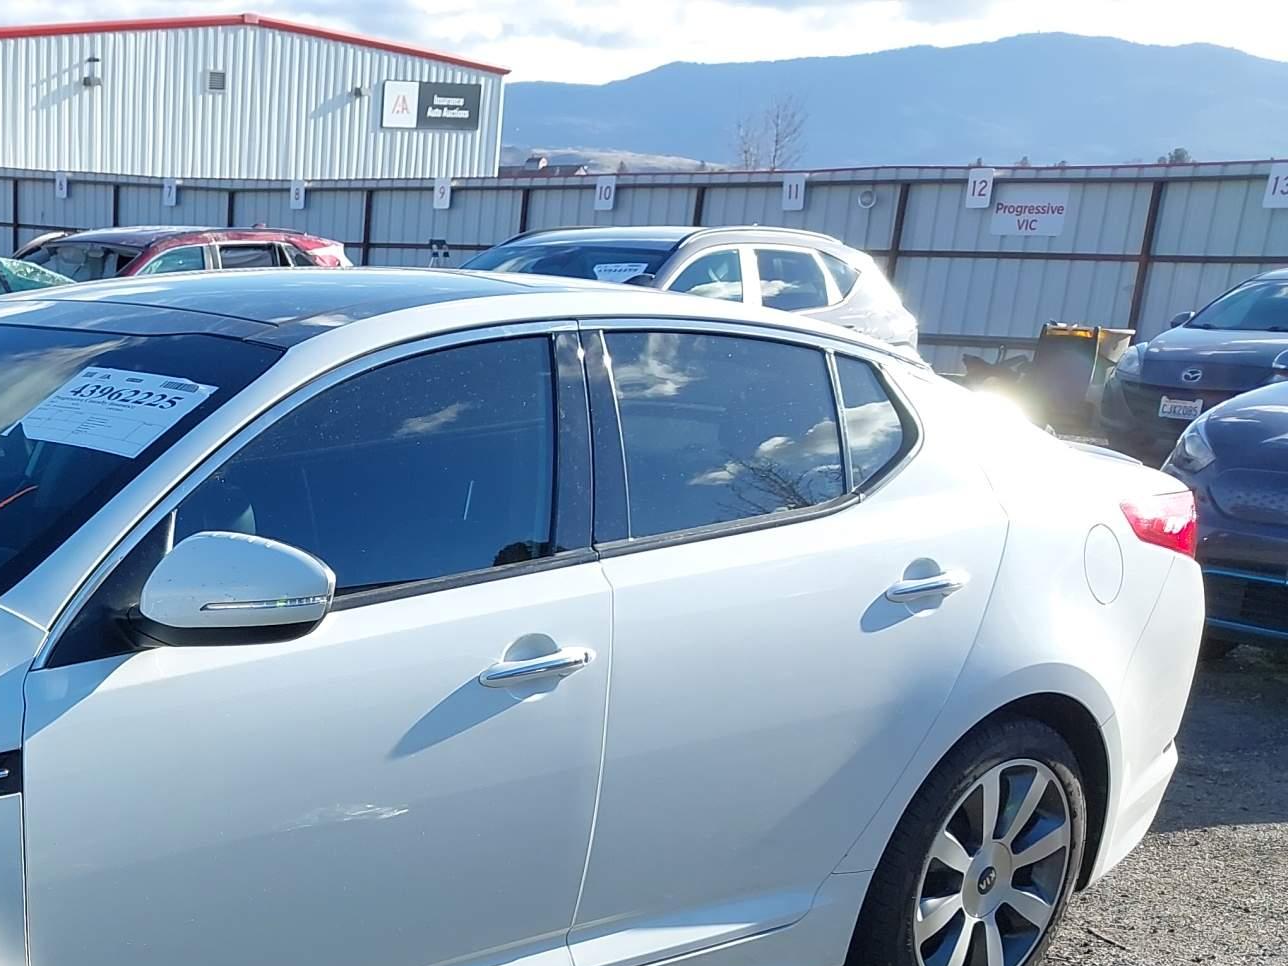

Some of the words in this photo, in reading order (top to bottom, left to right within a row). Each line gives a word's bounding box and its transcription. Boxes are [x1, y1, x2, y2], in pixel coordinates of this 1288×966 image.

[427, 106, 442, 117] Auto
[439, 185, 445, 199] 9
[598, 185, 612, 201] 10
[788, 183, 799, 200] 11
[971, 179, 988, 197] 12
[1271, 175, 1288, 196] 13
[295, 187, 300, 200] 8
[995, 202, 1065, 217] Progressive
[1016, 219, 1038, 231] VIC
[70, 383, 184, 410] 43962225
